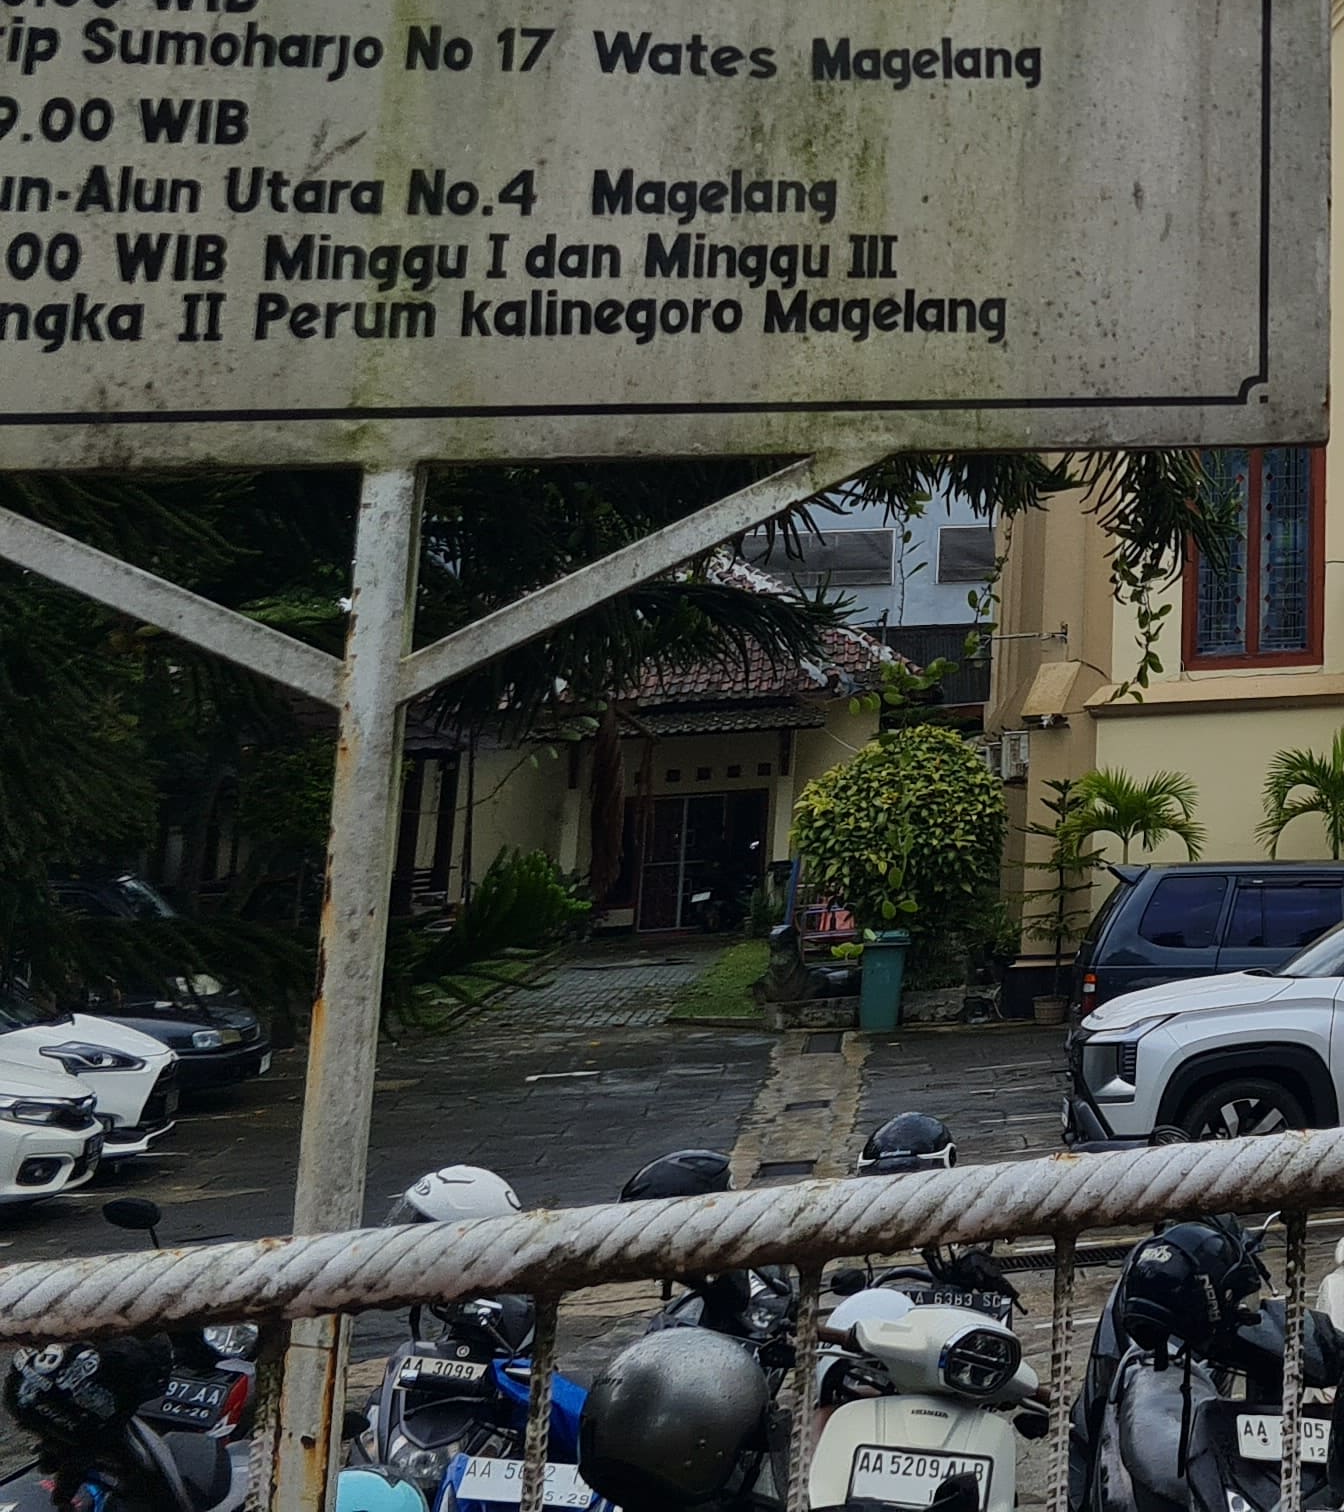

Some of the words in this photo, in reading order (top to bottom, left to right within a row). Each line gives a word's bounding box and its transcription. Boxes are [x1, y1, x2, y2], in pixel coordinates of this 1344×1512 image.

[0, 15, 59, 76] ip
[82, 17, 383, 82] Sumoharjo
[405, 25, 473, 72] No
[497, 27, 556, 72] 17
[593, 30, 778, 80] Wates
[810, 37, 1042, 91] Magelang
[139, 97, 249, 145] WIB
[224, 166, 385, 216] Utara
[406, 168, 537, 217] No.4
[591, 168, 837, 226] Magelang
[115, 232, 227, 285] WIB
[263, 233, 469, 293] Minggu
[485, 233, 510, 279] I
[644, 232, 830, 290] Minggu
[846, 233, 898, 279] III
[177, 291, 227, 343] II
[254, 287, 437, 341] Perum
[460, 289, 743, 346] kalinegoro
[763, 285, 1007, 344] Magelang
[432, 1361, 474, 1380] 3099
[1243, 1420, 1267, 1437] AA
[465, 1460, 492, 1478] AA
[859, 1452, 884, 1475] AA
[890, 1455, 940, 1479] 5209
